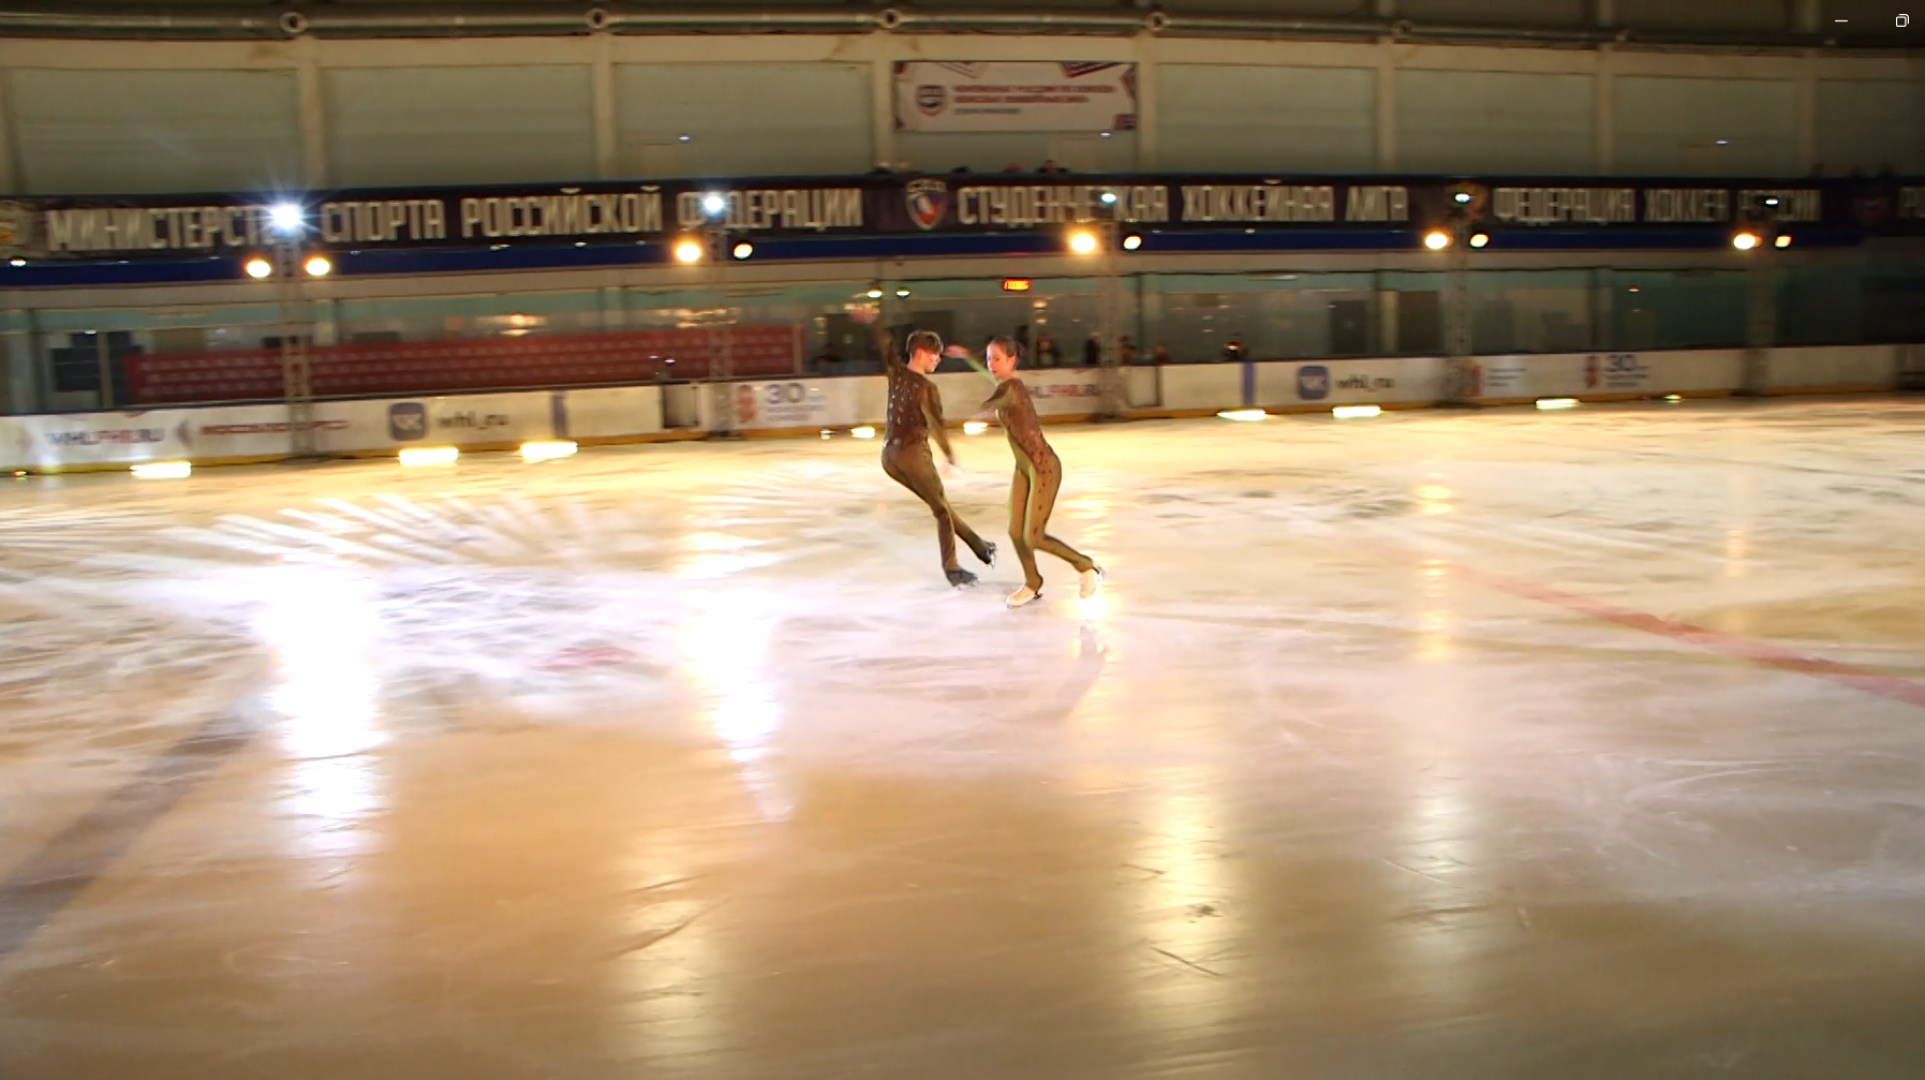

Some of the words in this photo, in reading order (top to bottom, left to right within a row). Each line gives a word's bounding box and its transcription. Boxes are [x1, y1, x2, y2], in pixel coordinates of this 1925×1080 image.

[45, 203, 306, 252] МИНИСТЕРСТ
[321, 198, 448, 244] СПОРТА
[461, 185, 664, 239] РОССИЙСКОЙ
[676, 187, 865, 232] ФДЕРАЦИИ
[1181, 178, 1335, 222] ХОККЕЙНАЯ
[1345, 185, 1410, 222] ЛИГА
[1493, 187, 1637, 226] ФЕДЕРАЦИЯ
[1643, 188, 1730, 222] ХОККЕЯ
[1737, 188, 1822, 222] РСИИ
[765, 382, 806, 405] 30
